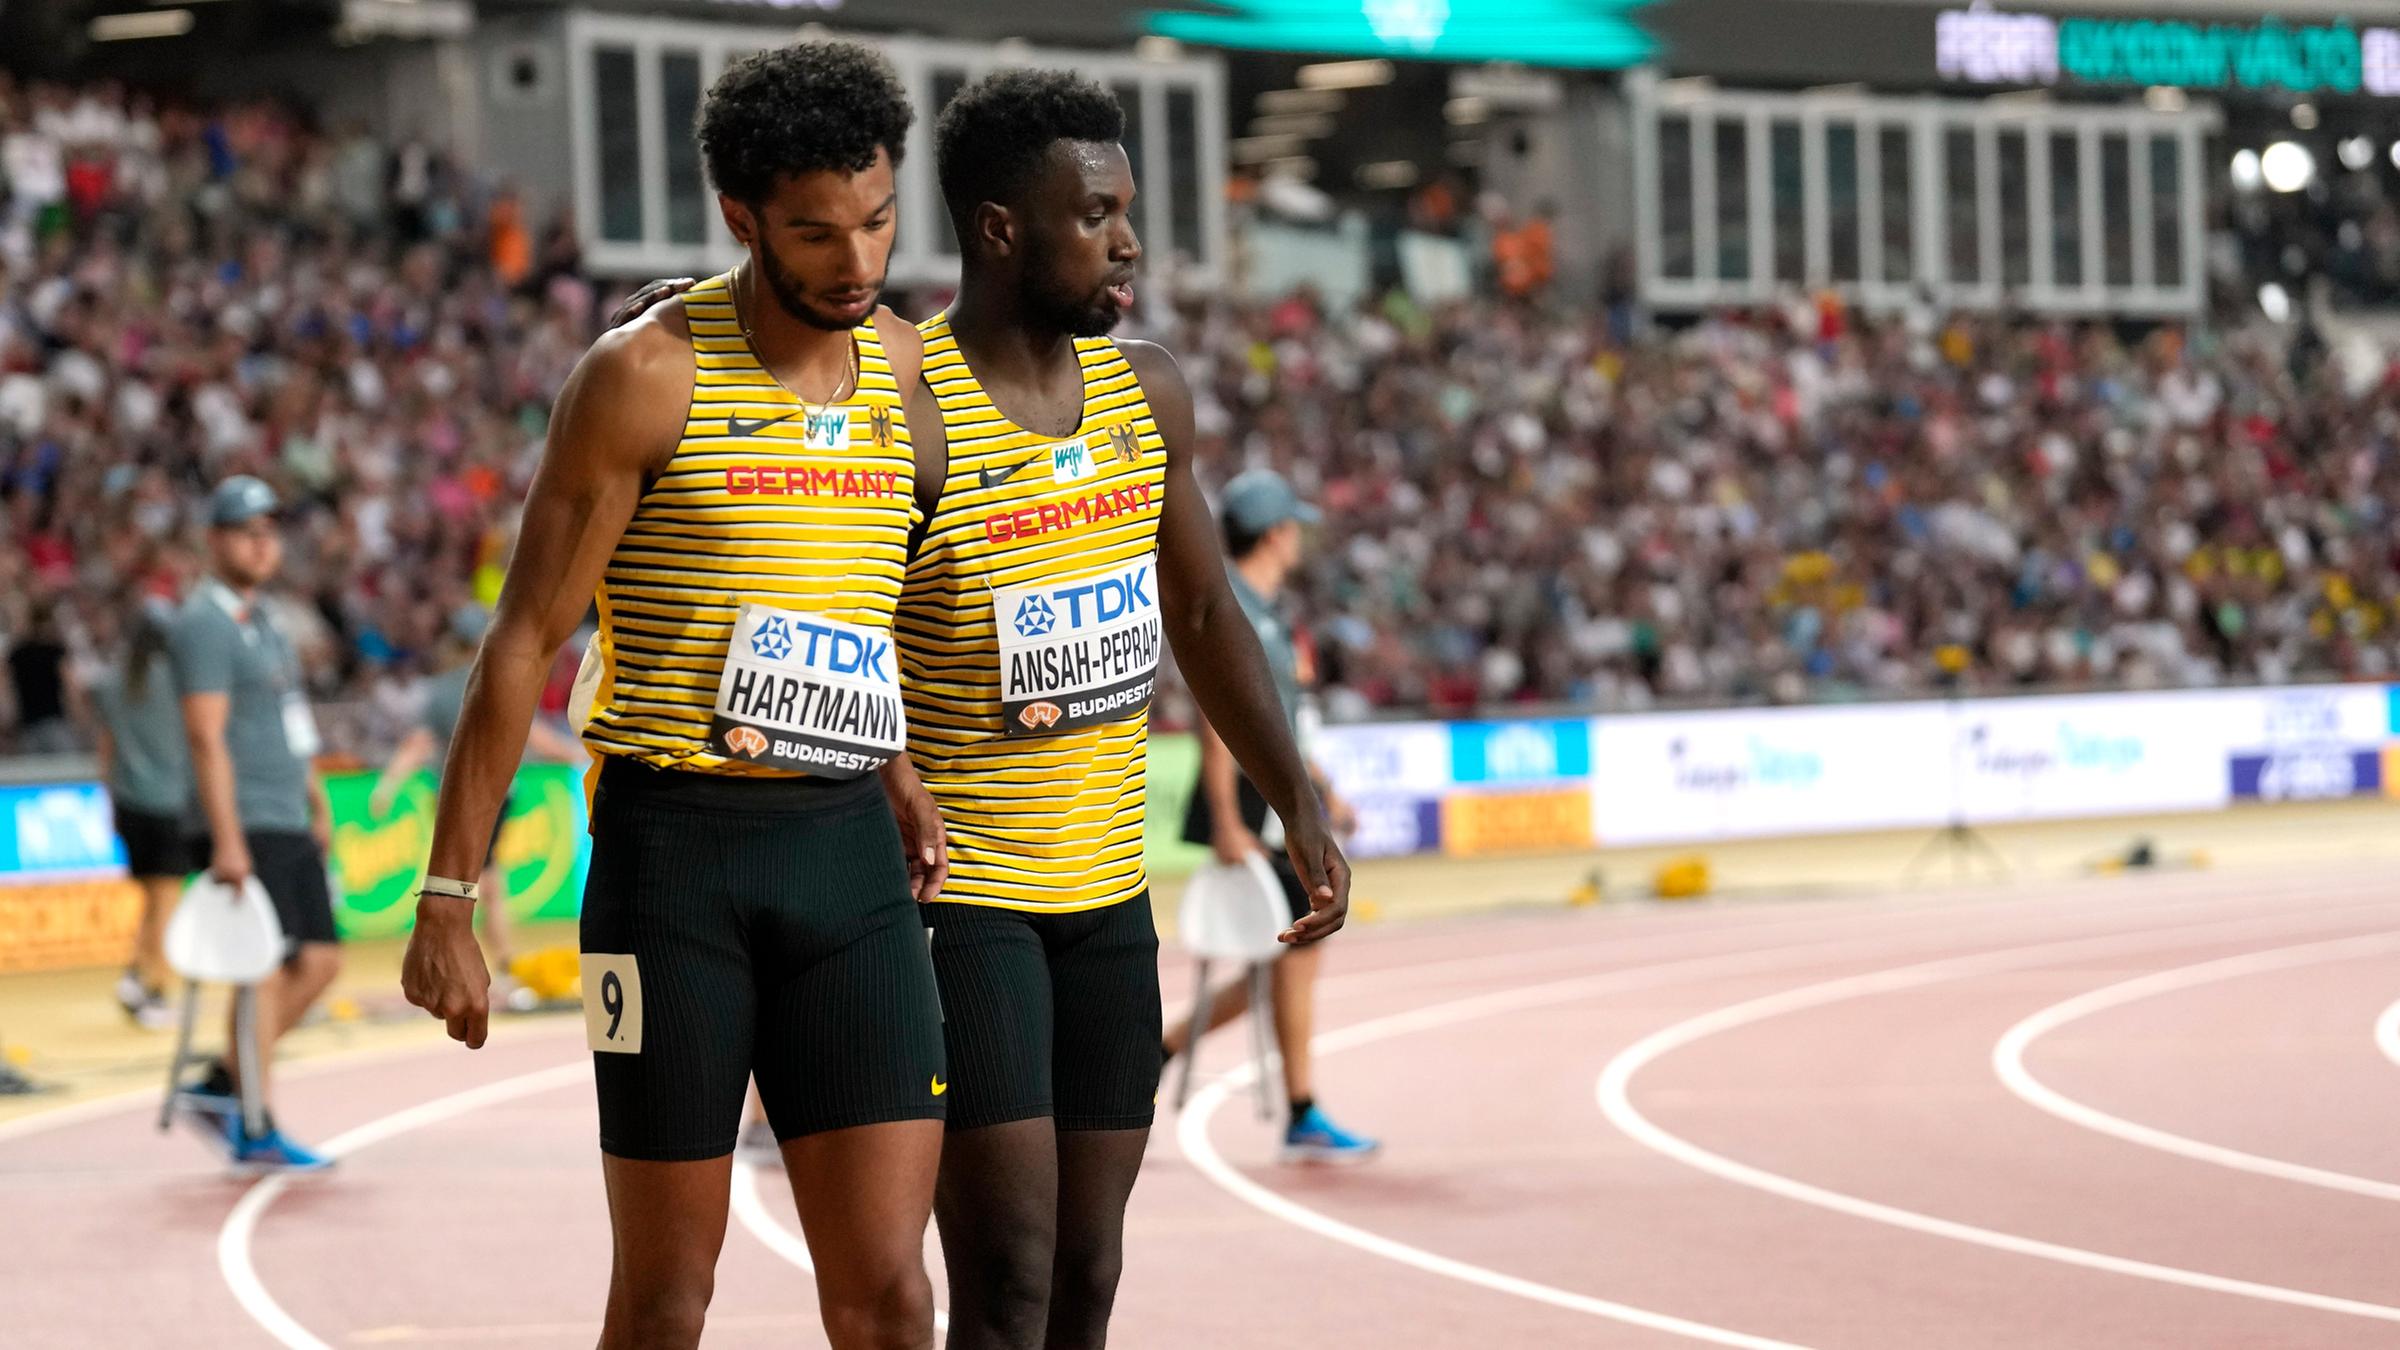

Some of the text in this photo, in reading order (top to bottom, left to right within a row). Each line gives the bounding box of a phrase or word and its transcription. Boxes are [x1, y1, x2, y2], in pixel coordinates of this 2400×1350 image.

[725, 465, 898, 499] GERMANY
[985, 481, 1151, 544] GERMANY
[1053, 566, 1151, 629] TDK
[796, 621, 890, 684] TDK
[1009, 618, 1158, 695] ANSAH-PEPRAH
[727, 668, 898, 743] HARTMANN
